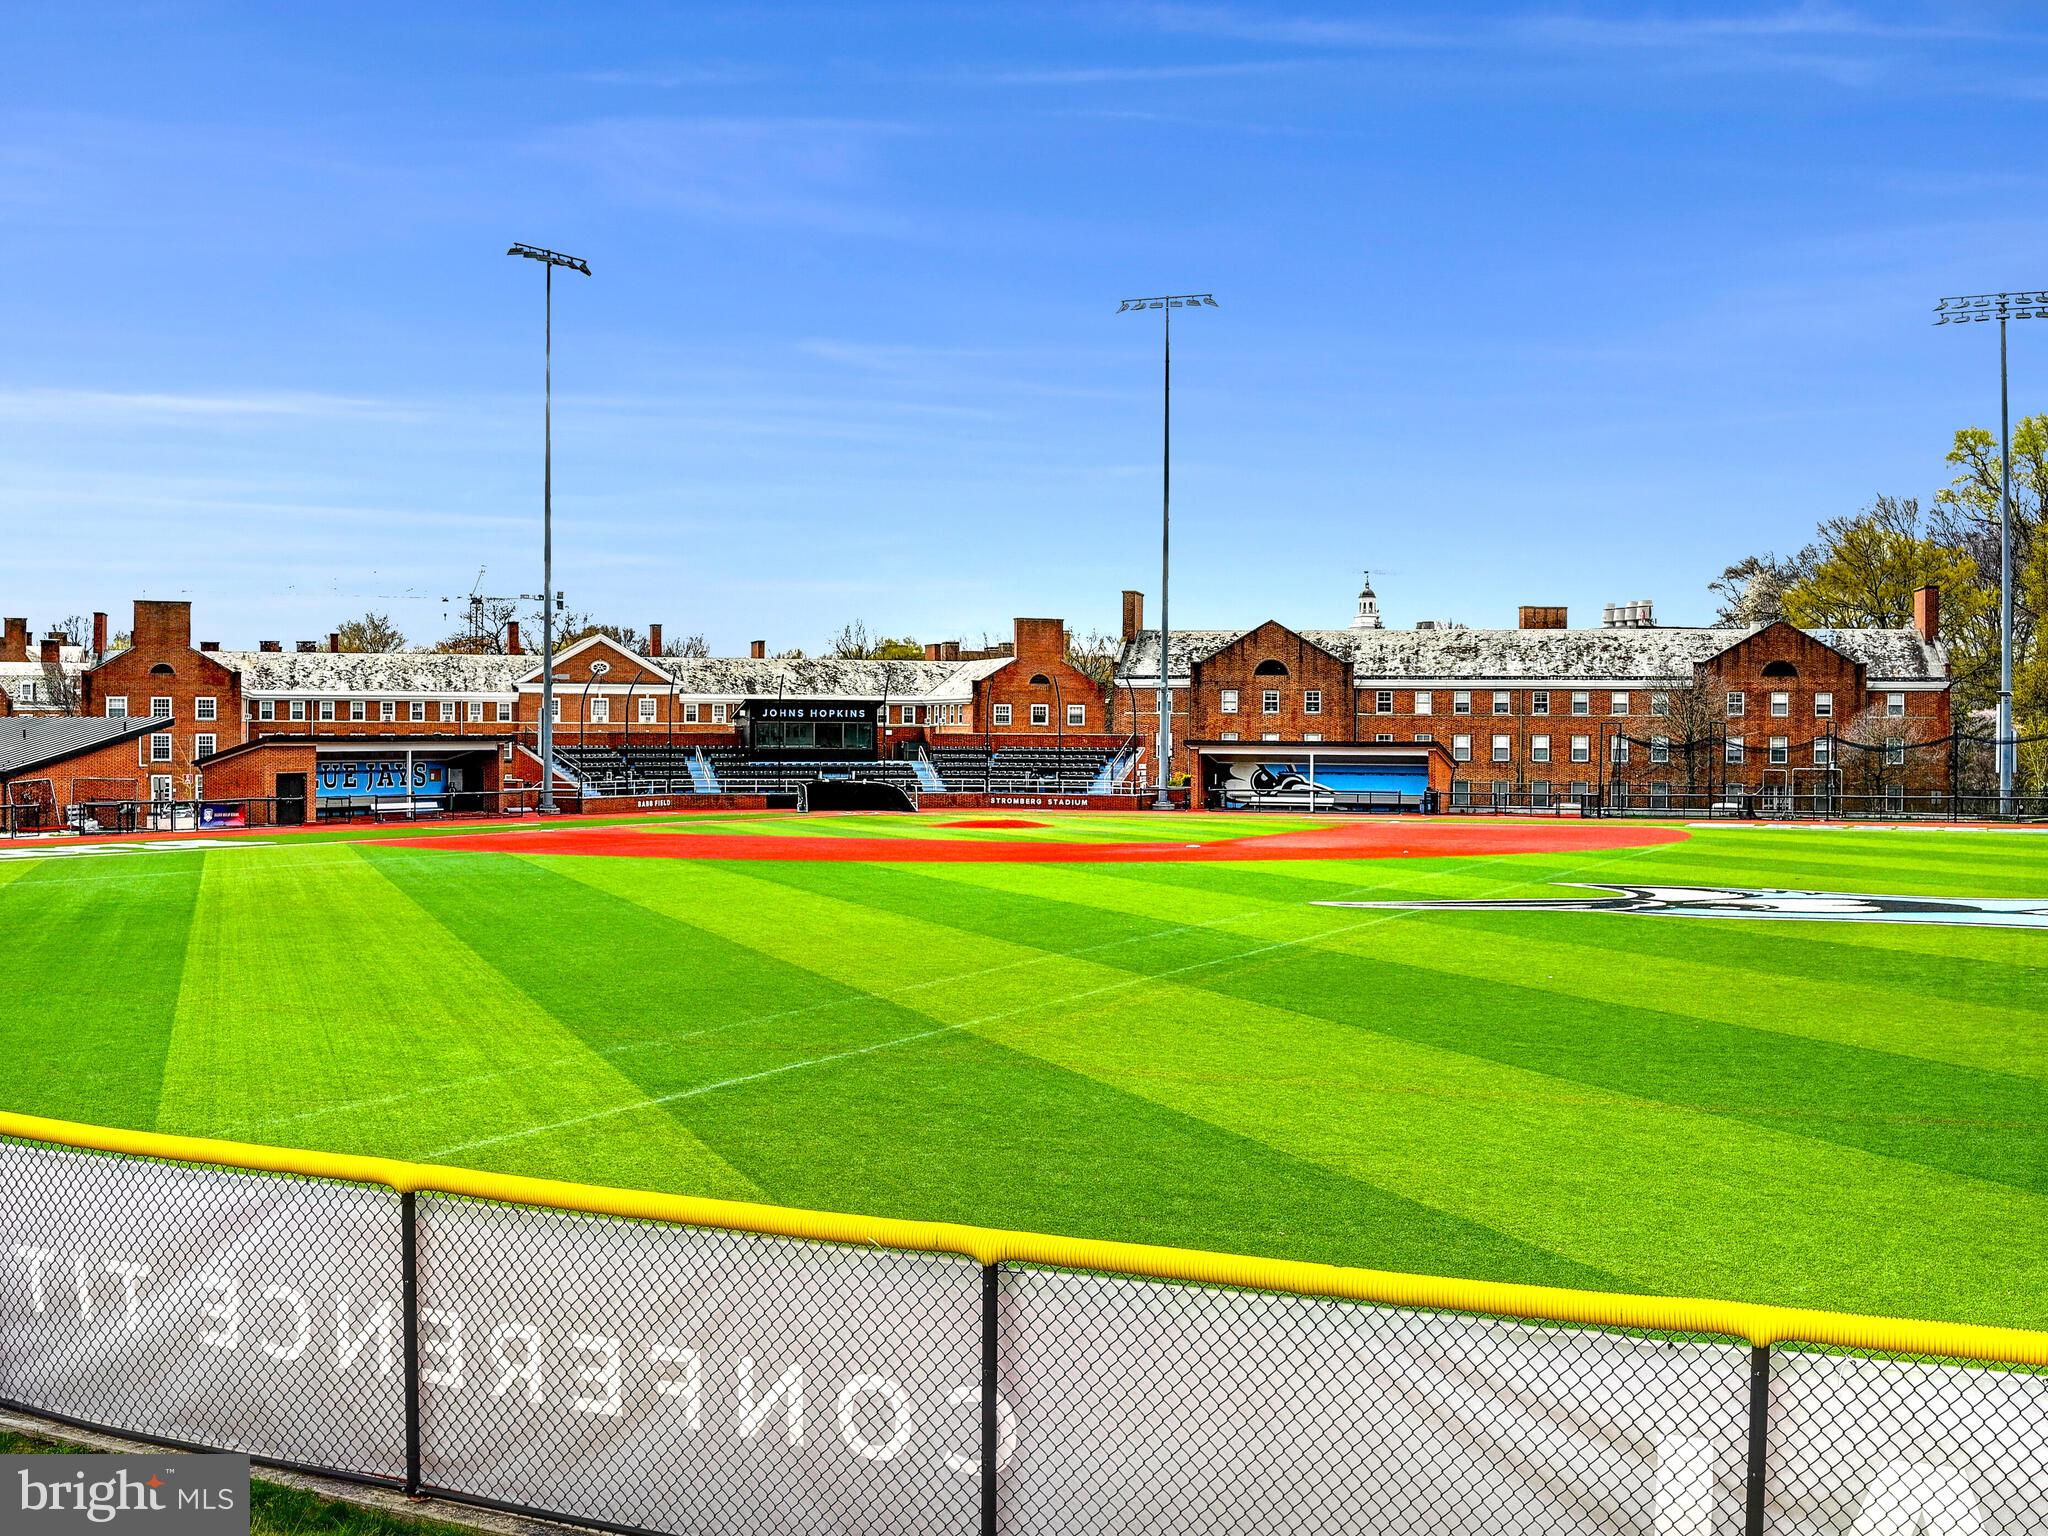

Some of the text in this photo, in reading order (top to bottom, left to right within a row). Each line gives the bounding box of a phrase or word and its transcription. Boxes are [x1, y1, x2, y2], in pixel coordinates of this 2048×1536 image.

[762, 708, 866, 718] JOHNS HOPKINS
[316, 761, 427, 792] UE JAYS
[654, 799, 671, 807] FIELD
[990, 797, 1088, 806] STROMBERG STADIUM
